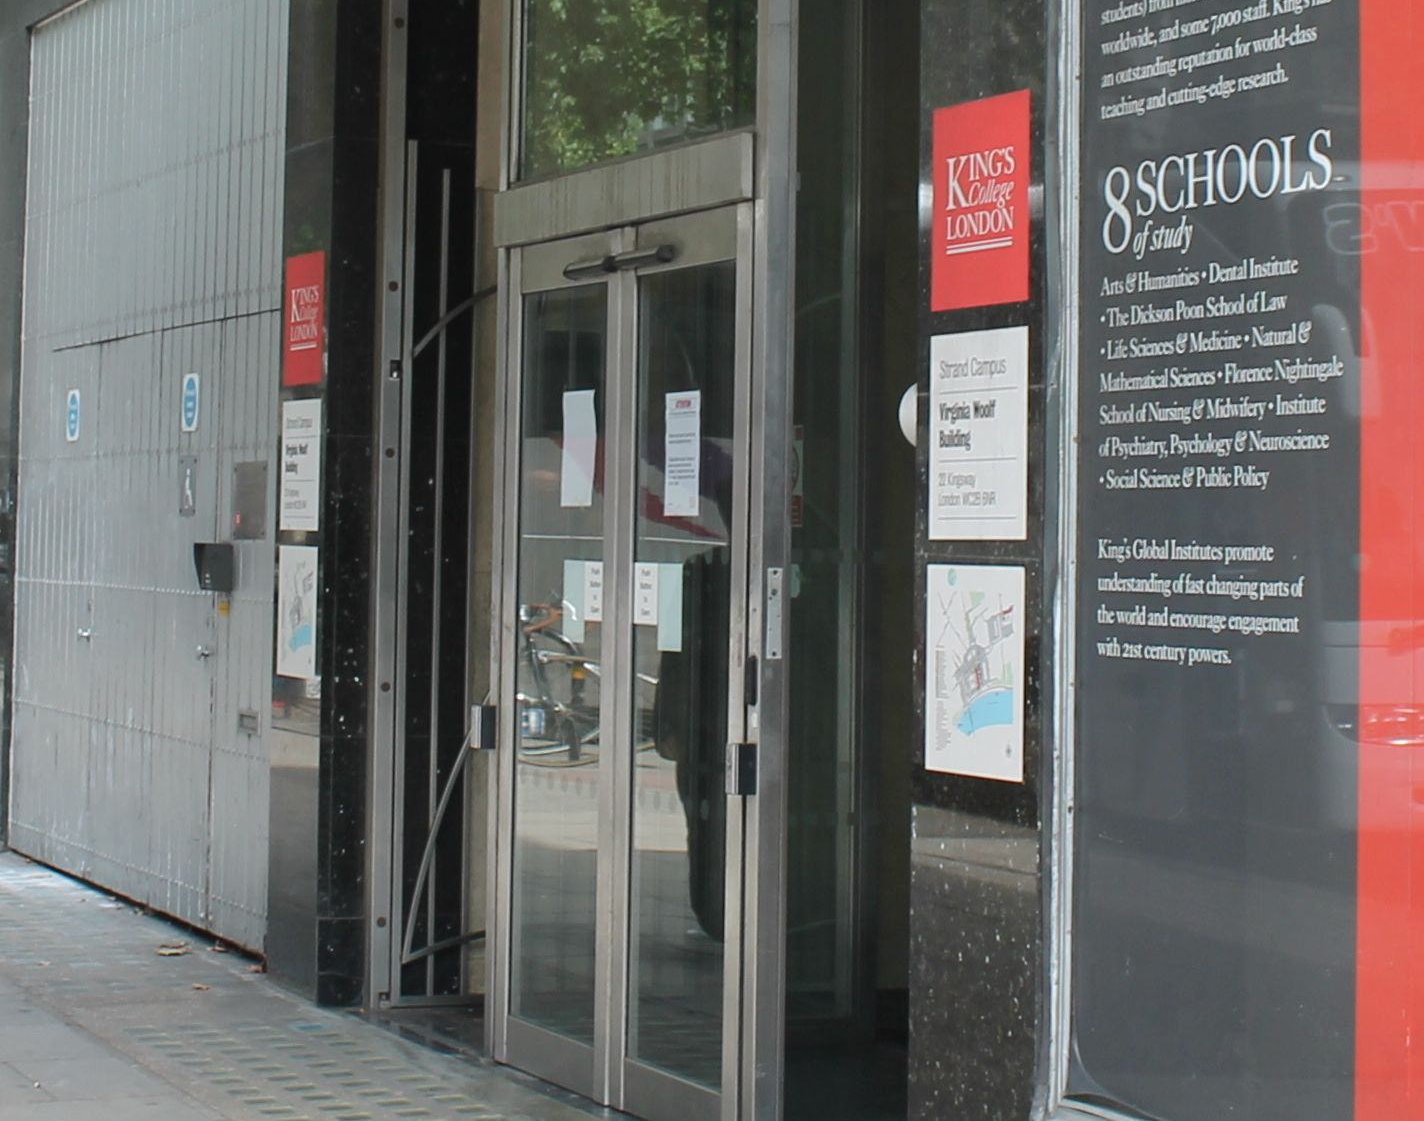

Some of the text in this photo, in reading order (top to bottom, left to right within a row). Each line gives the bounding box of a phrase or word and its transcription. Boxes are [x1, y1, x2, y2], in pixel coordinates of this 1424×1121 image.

[1101, 26, 1158, 54] worldwide,
[1158, 18, 1179, 43] and
[1180, 18, 1210, 38] some
[1210, 9, 1241, 35] 7,000
[1100, 23, 1317, 88] an outstanding reputation for world-class
[1100, 62, 1289, 120] teaching and cutting-edge research.
[968, 178, 1015, 208] College
[1102, 129, 1334, 253] 8 SCHOOLS
[946, 206, 1014, 240] LONDON
[1132, 214, 1193, 260] of study
[1100, 255, 1299, 296] Arts & Humanities Dental Institute
[1106, 290, 1288, 327] The Dickson Poon School of Law
[1106, 320, 1312, 360] Life Sciences & Medicine Natural &
[939, 356, 1007, 380] Strand Campus
[1099, 354, 1344, 392] Mathematical Sciences Florence Nightingale
[939, 399, 997, 425] Virginia Woolf
[1099, 393, 1326, 425] School of Nursing & Midwifery Institute
[938, 429, 971, 451] Building
[1098, 428, 1330, 460] of Psychiatry, Psychology & Neuroscience
[1105, 465, 1270, 490] Social Science & Public Policy
[1097, 537, 1274, 565] King's Global Institutes promote
[1097, 571, 1305, 601] understanding of fast changing parts of
[1097, 603, 1300, 636] the world and encourage engagement
[1096, 636, 1232, 666] with 21st century powers.
